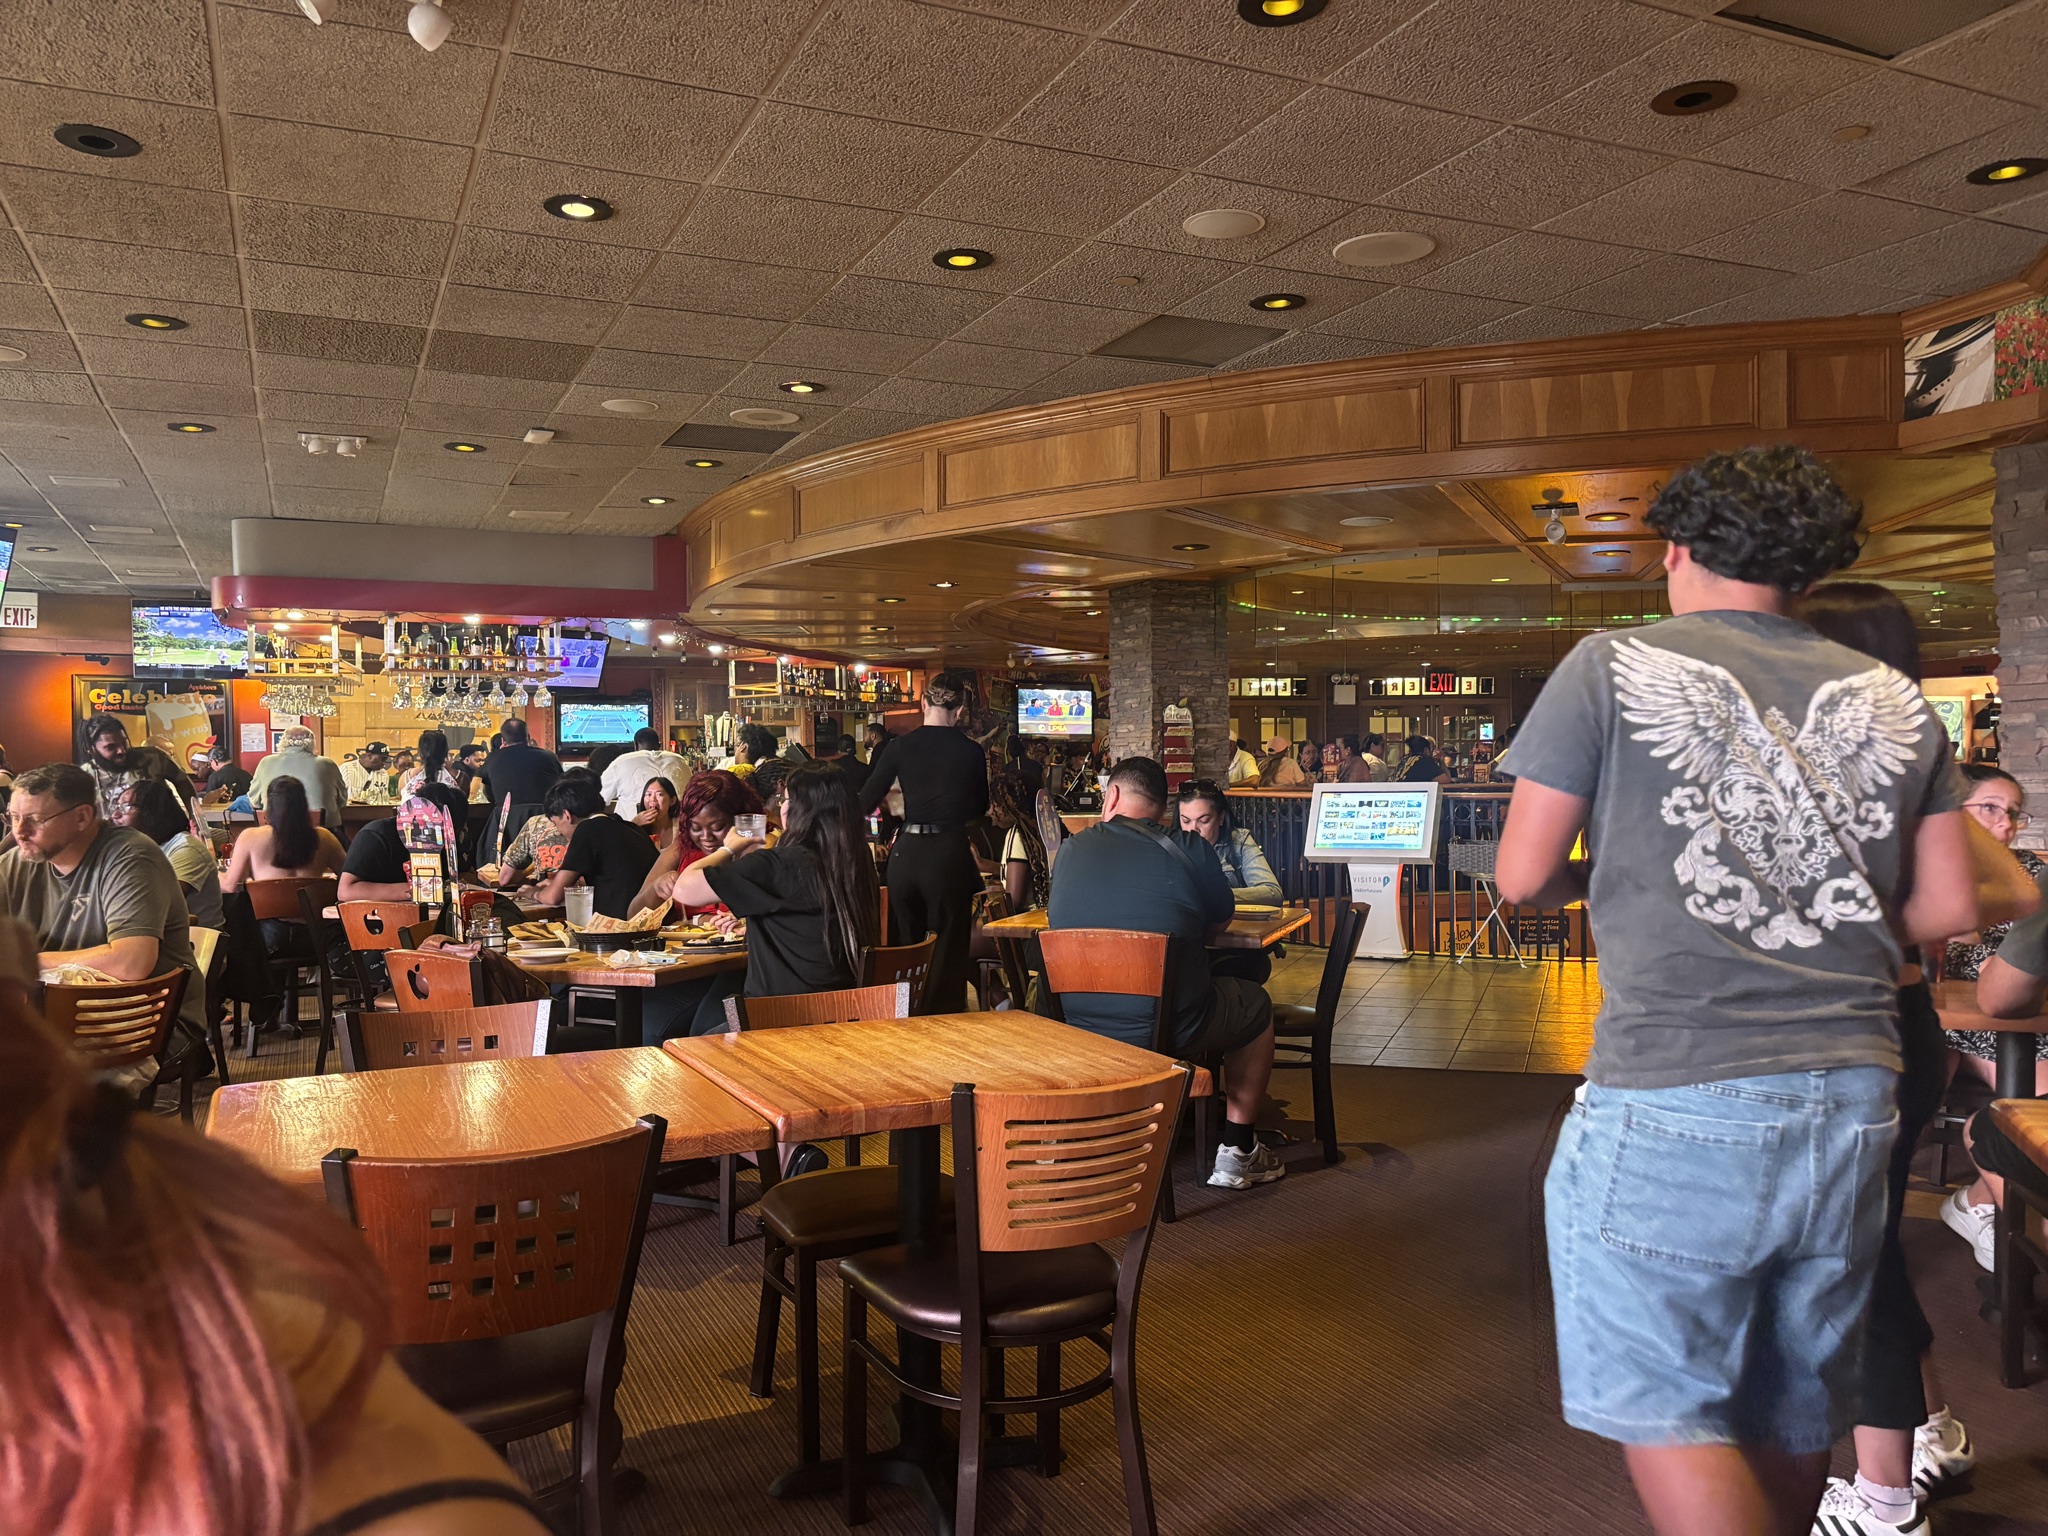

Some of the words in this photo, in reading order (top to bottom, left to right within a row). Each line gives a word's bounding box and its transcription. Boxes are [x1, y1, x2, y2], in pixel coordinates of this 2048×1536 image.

[4, 607, 31, 626] EXIT
[1429, 673, 1454, 692] EXIT
[89, 688, 217, 704] Celebrate
[1176, 712, 1191, 720] Cards
